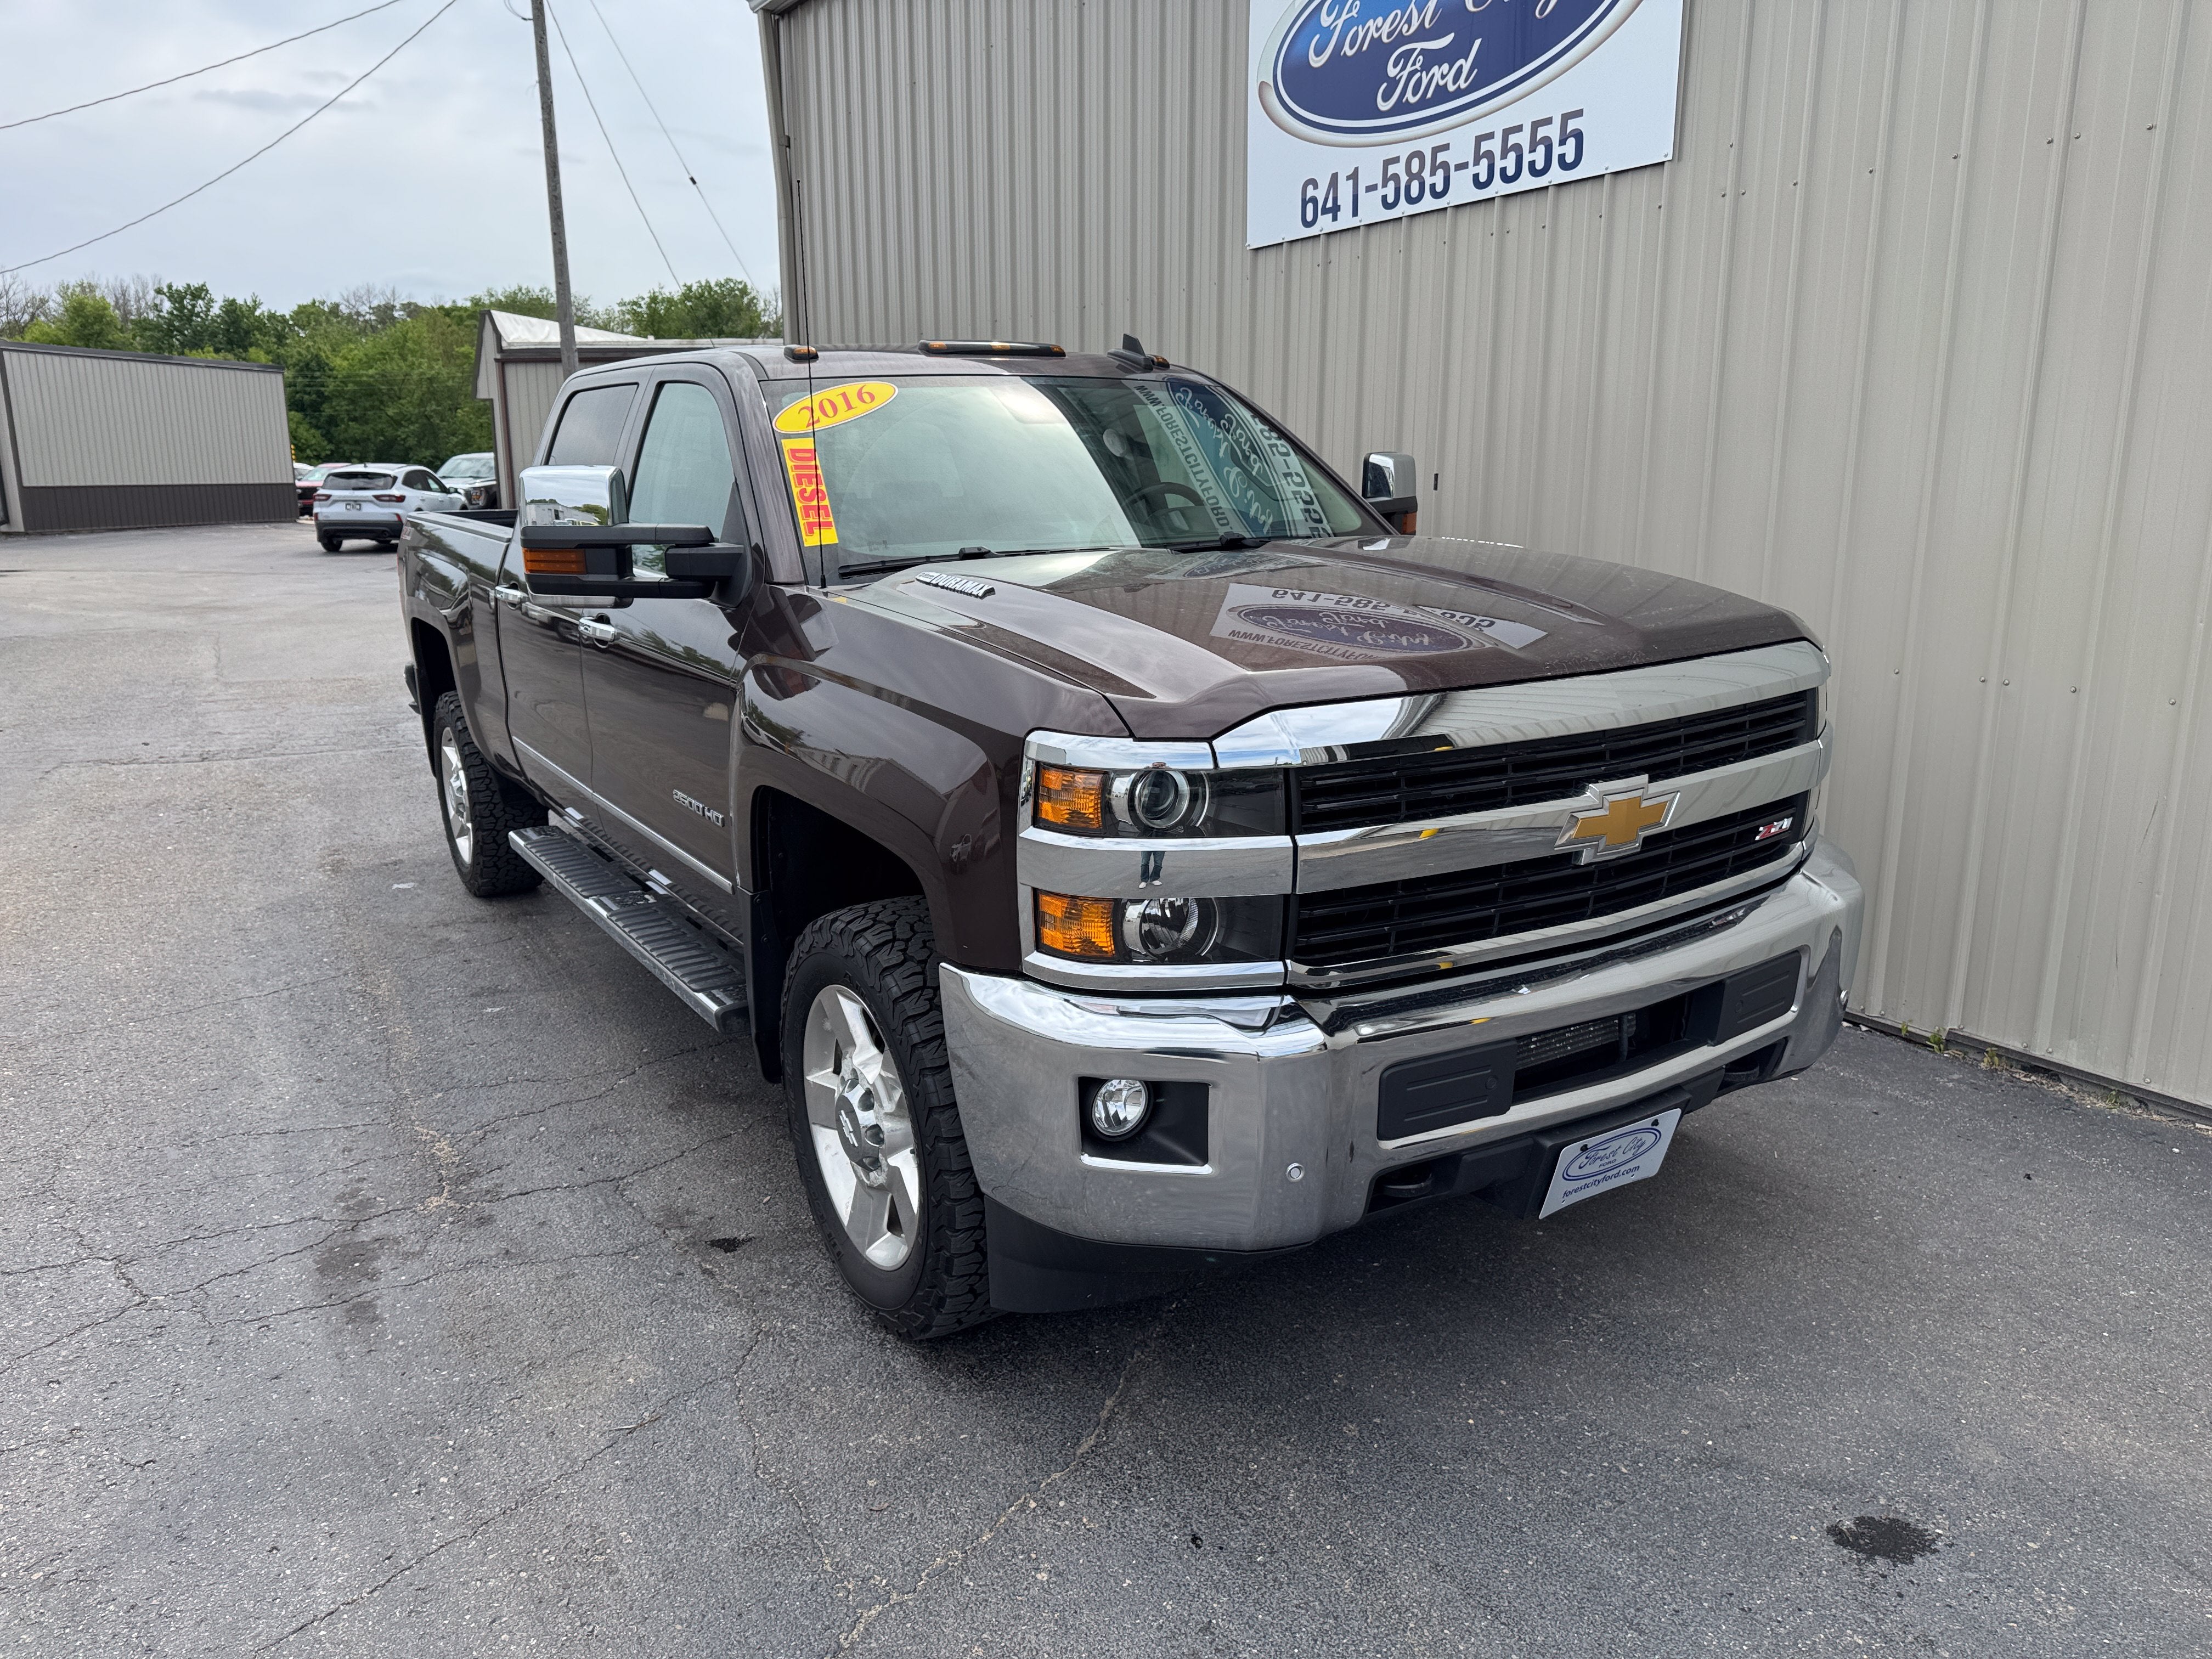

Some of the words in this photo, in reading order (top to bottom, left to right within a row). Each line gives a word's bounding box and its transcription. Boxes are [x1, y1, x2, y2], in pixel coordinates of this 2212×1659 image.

[1376, 32, 1482, 111] Ford
[1301, 108, 1584, 229] 641-585-5555
[798, 385, 876, 428] 2016
[788, 448, 833, 537] DIESEL
[930, 573, 995, 597] DURAMAX
[673, 789, 705, 816] 2500
[704, 806, 725, 827] HD
[1754, 816, 1793, 840] Z71
[1578, 1145, 1622, 1170] Forest
[1622, 1136, 1646, 1156] City
[1598, 1158, 1617, 1169] FORD
[1562, 1165, 1640, 1199] forestcityford.com
